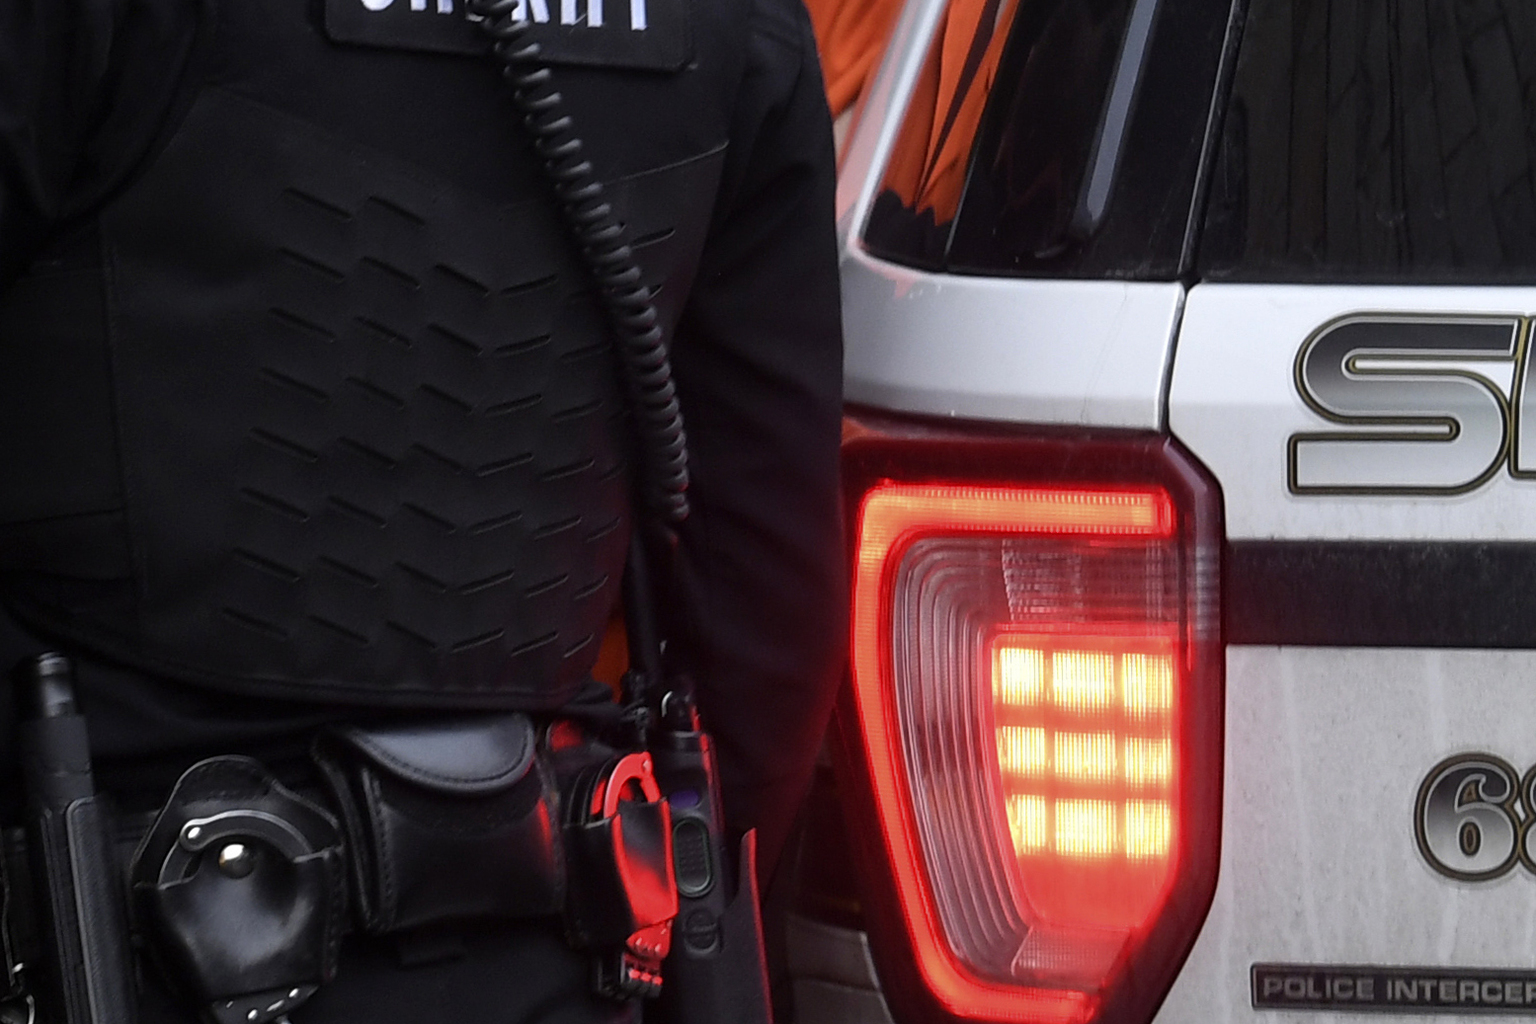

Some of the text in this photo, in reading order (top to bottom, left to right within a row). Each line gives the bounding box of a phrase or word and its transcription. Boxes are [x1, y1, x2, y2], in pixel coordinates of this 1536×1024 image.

[1286, 311, 1536, 497] S
[1413, 751, 1536, 884] 6
[1264, 977, 1375, 1001] POLICE
